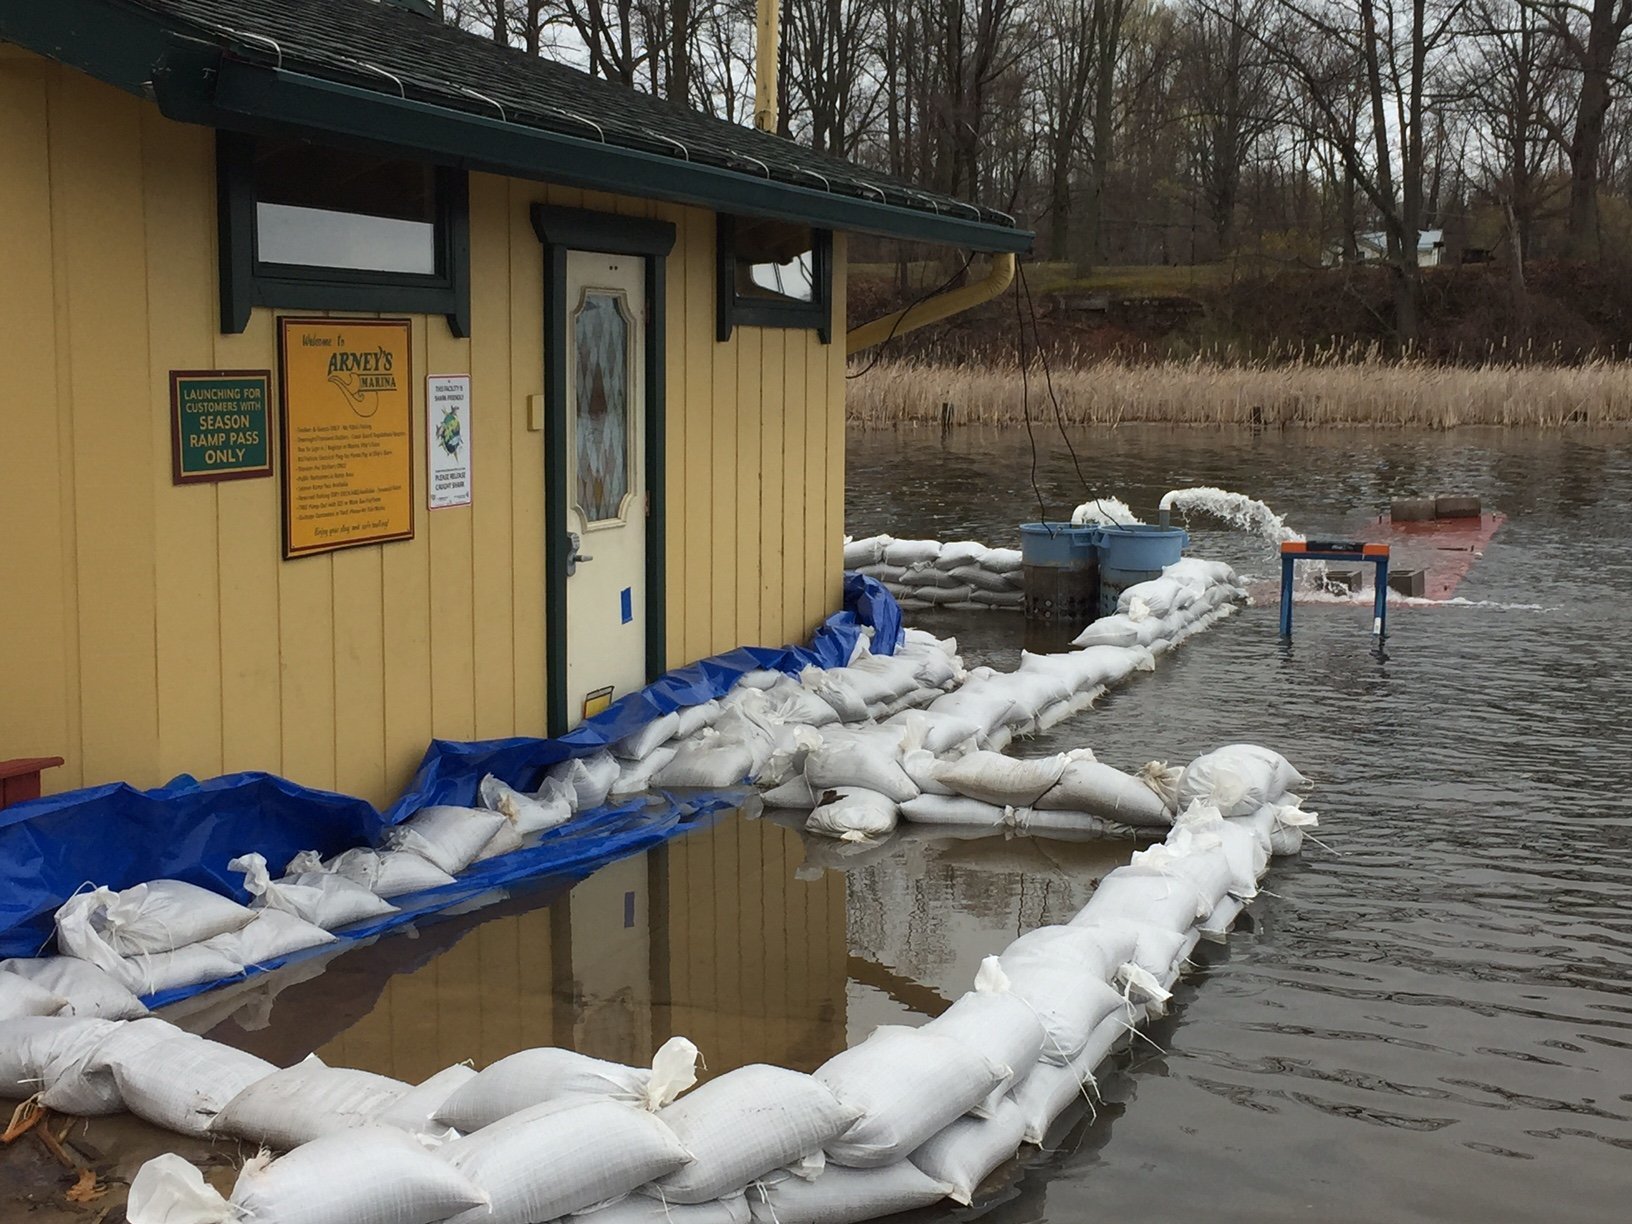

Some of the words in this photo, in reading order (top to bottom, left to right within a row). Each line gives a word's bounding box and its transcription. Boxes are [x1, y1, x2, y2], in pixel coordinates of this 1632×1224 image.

[328, 346, 393, 376] ARNEY'S
[361, 376, 396, 388] MARINA
[184, 389, 241, 400] LAUNCHING
[244, 388, 261, 399] FOR
[186, 402, 238, 412] CUSTOMERS
[240, 401, 261, 412] WITH
[200, 415, 249, 430] SEASON
[190, 432, 226, 448] RAMP
[229, 431, 260, 446] PASS
[205, 449, 246, 464] ONLY
